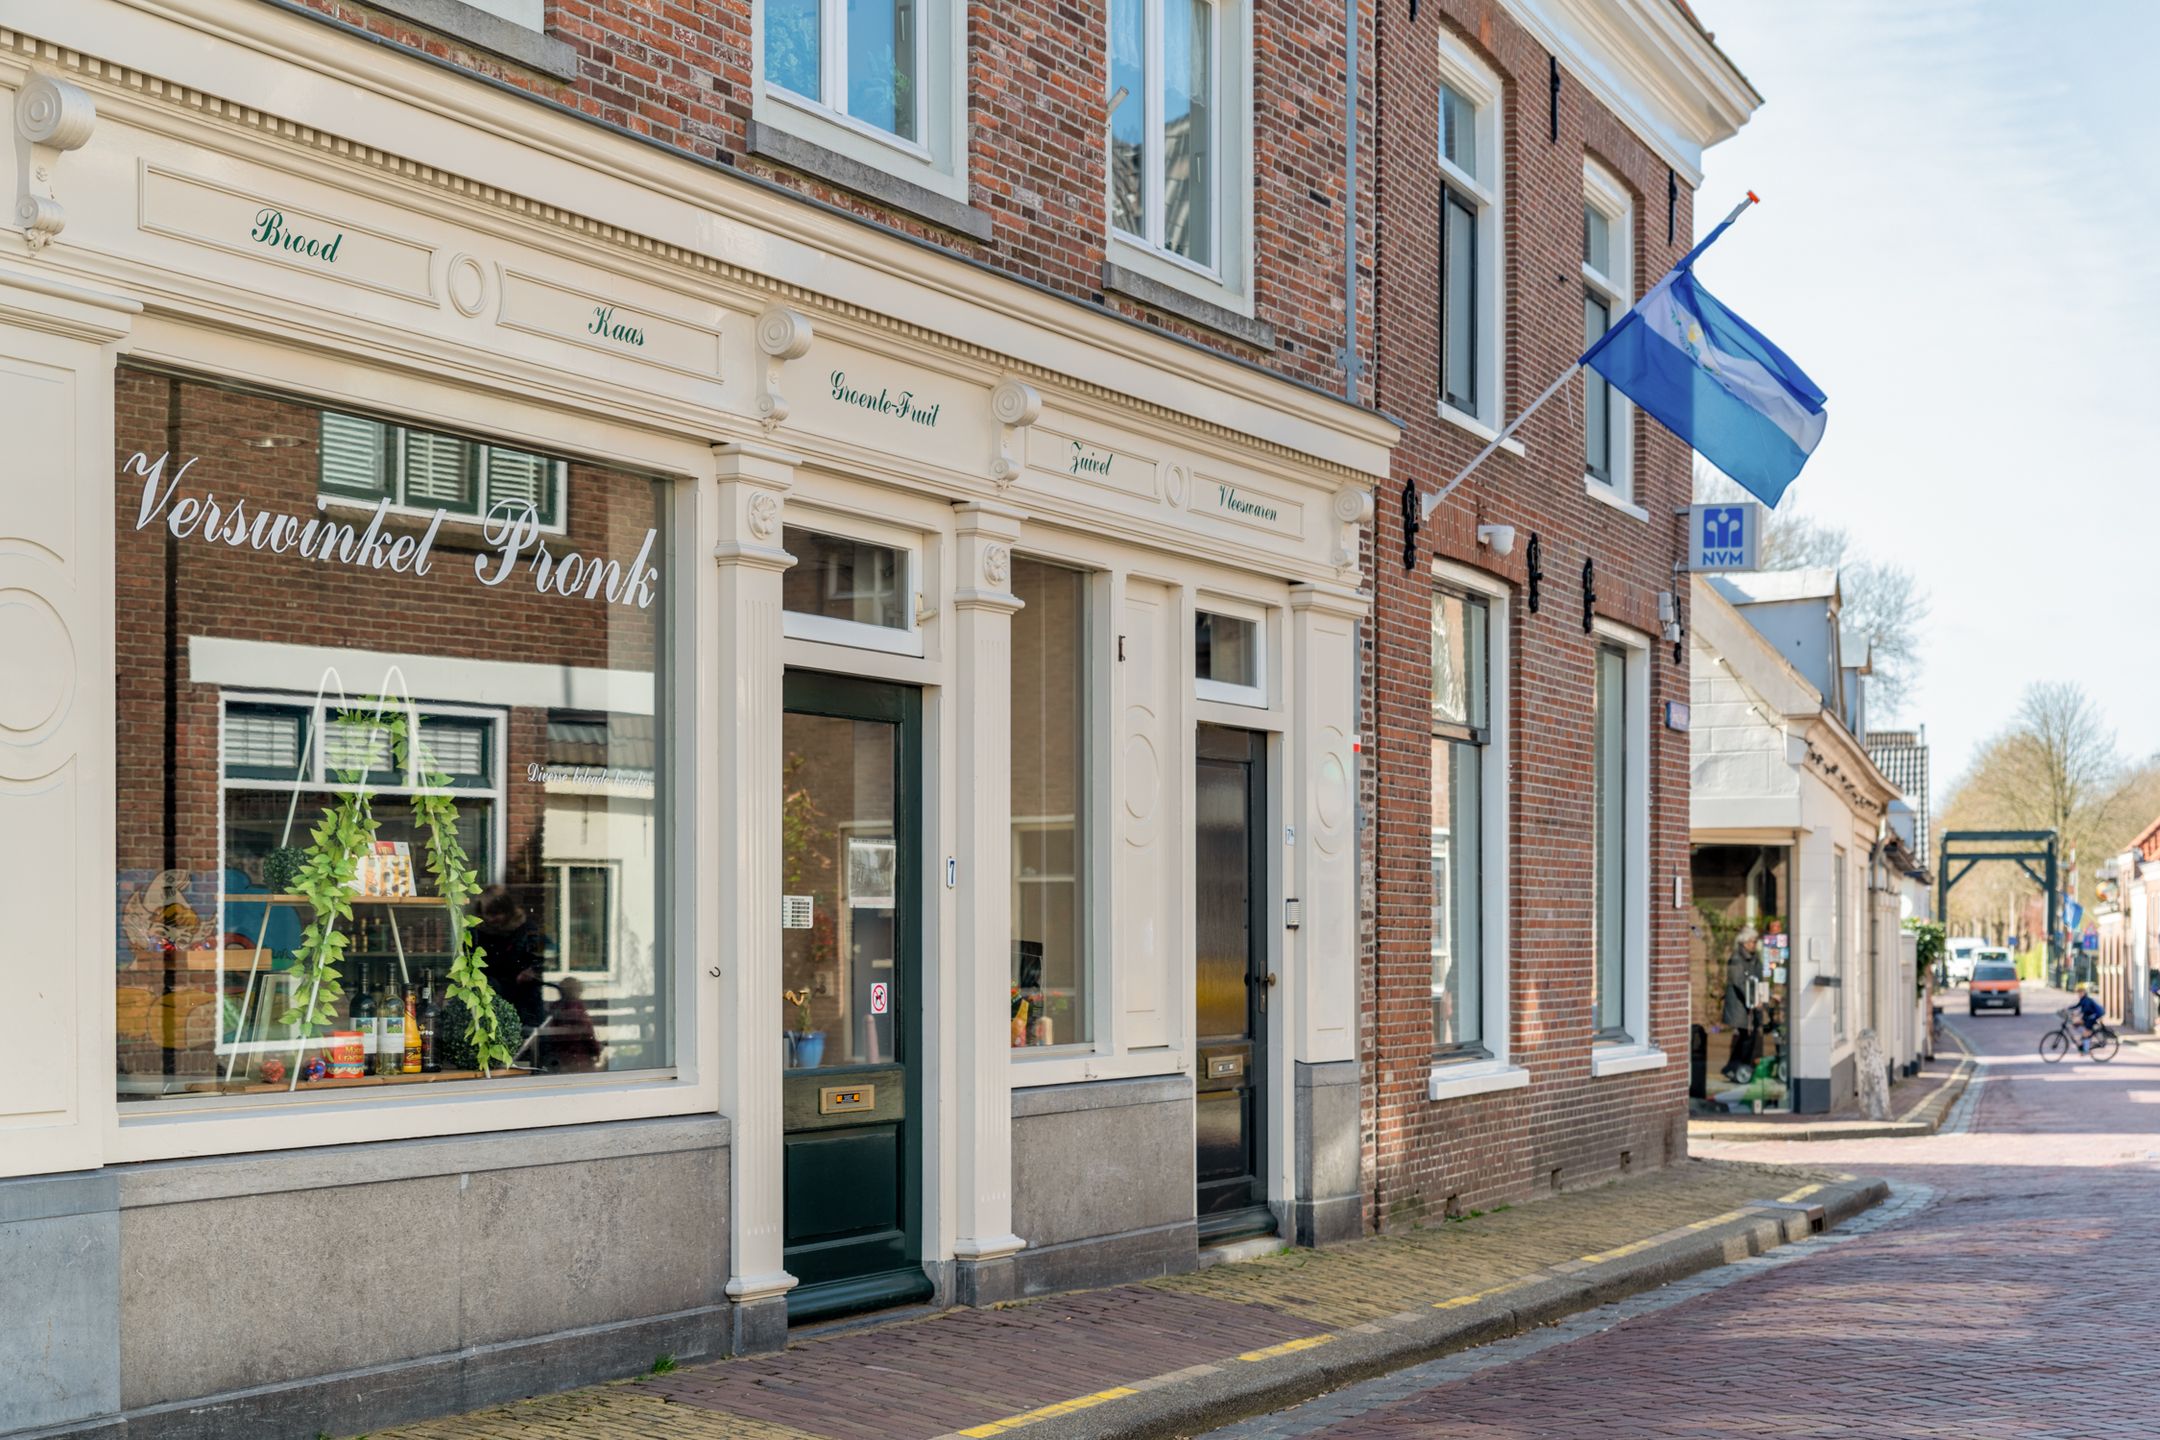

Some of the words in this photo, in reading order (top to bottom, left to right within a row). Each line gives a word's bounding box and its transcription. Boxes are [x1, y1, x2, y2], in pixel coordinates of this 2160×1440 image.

[251, 208, 342, 263] Brood
[588, 305, 645, 347] Kaas
[830, 369, 940, 427] Groente-Fruit
[1070, 441, 1114, 476] Zuivel
[1218, 484, 1278, 521] Vleeswaren
[123, 451, 447, 577] Verswinkel
[474, 497, 659, 609] Pronk
[1702, 551, 1743, 566] NVM
[949, 860, 956, 885] 7
